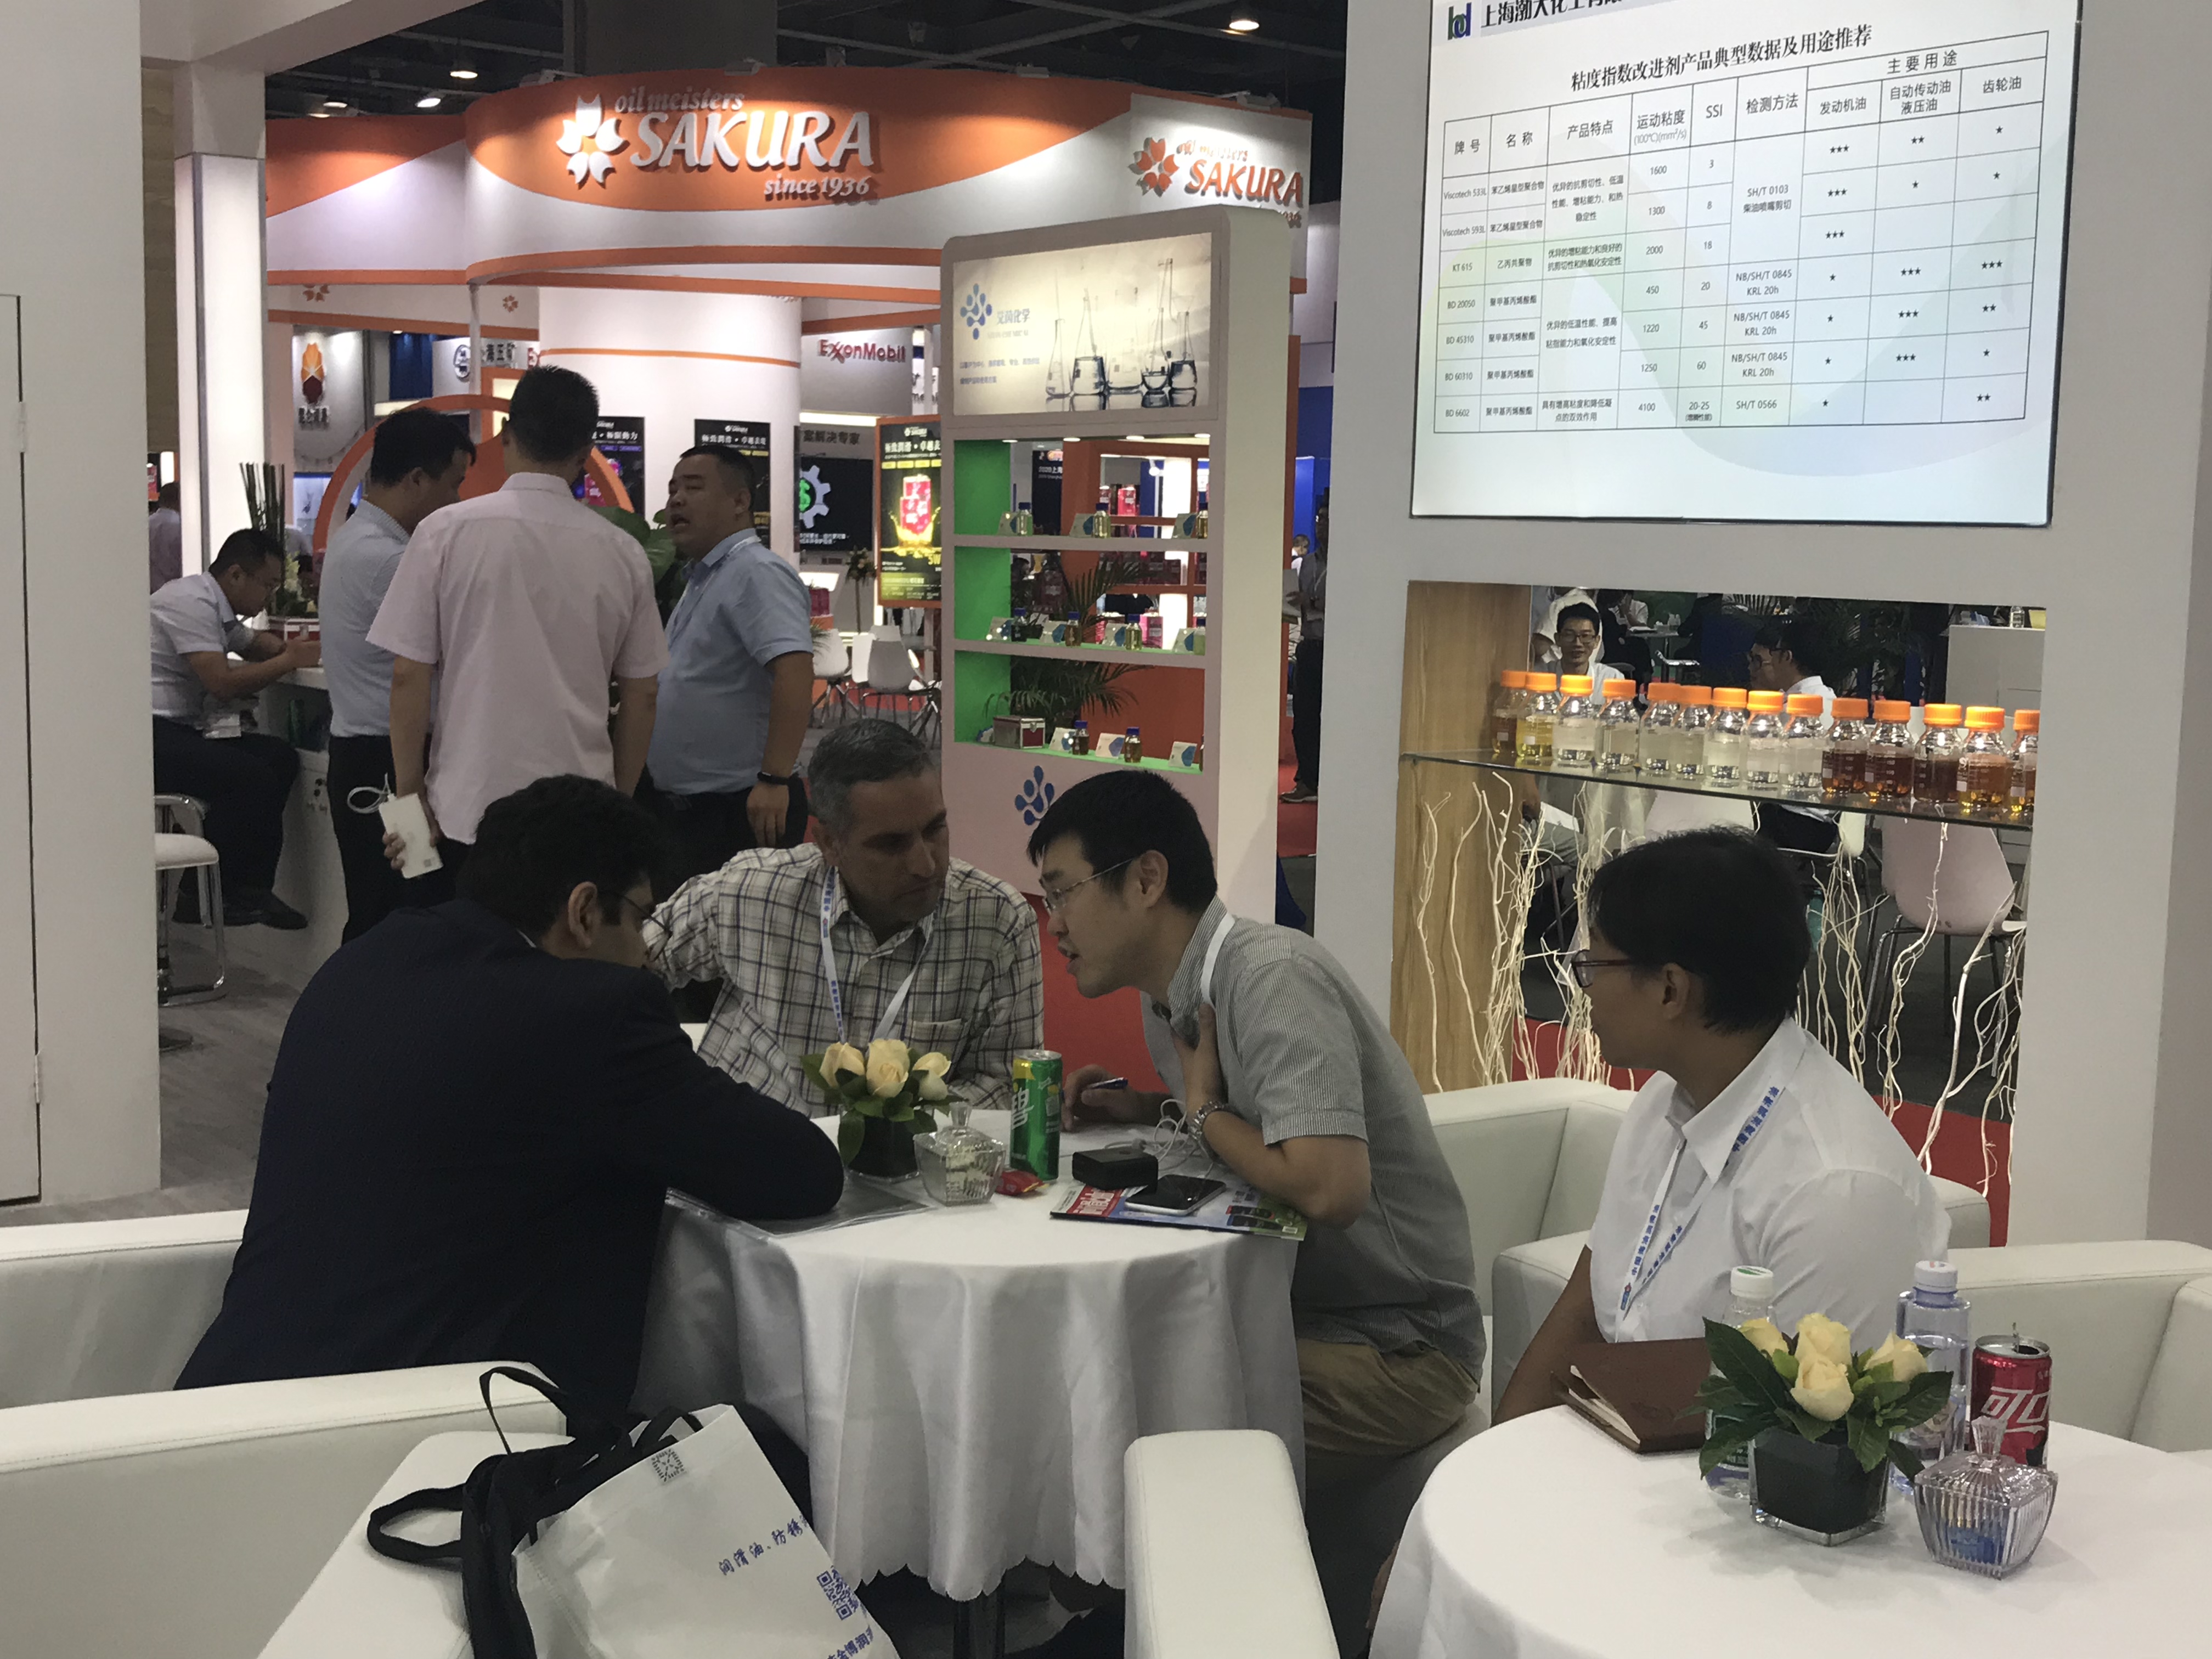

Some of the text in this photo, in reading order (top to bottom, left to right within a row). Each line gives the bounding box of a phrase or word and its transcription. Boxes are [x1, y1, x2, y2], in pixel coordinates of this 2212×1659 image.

[1480, 0, 1617, 28] 上海渤大化
[1571, 24, 1872, 92] 粘度指数改进剂产品典型数据及用途推荐
[1887, 49, 1959, 75] 主要用途
[1889, 79, 1952, 101] 自动传动油
[1982, 76, 2022, 94] 齿轮油
[614, 86, 744, 112] oil meisters
[1746, 93, 1799, 115] 检测方法
[1706, 104, 1723, 119] SSI
[1819, 97, 1867, 116] 发动机油
[1900, 98, 1938, 115] 液压油
[1637, 109, 1686, 130] 运动粘度
[1567, 120, 1613, 140] 产品特点
[629, 111, 874, 168] SAKURA
[1506, 131, 1533, 148] 名称
[1454, 138, 1481, 155] 牌号
[1709, 159, 1714, 168] 3
[1650, 165, 1667, 176] 1600
[764, 176, 870, 197] since 1936
[1187, 159, 1302, 205] SAKURA
[1443, 188, 1472, 200] Viscotech
[1747, 184, 1789, 198] SH/T 0103
[1648, 206, 1666, 216] 1300
[1707, 201, 1712, 210] 8
[1442, 227, 1470, 238] Viscotech
[1646, 245, 1664, 255] 2000
[1703, 240, 1712, 250] 18
[1452, 262, 1473, 272] KT 615
[1735, 268, 1792, 283] NB/SH/T 0845
[1646, 285, 1660, 295] 450
[1701, 281, 1711, 291] 20
[1747, 285, 1779, 296] KRL 20h
[1447, 300, 1476, 309] BD 20050
[1734, 309, 1790, 322] NB/SH/T 0845
[1643, 324, 1660, 334] 1220
[1699, 320, 1708, 330] 45
[1745, 326, 1777, 336] KRL 20h
[1446, 335, 1475, 345] BD 45310
[819, 339, 906, 363] ExxonMobil
[1731, 351, 1788, 363] NB/SH/T 0845
[1641, 363, 1658, 373] 1250
[1696, 360, 1707, 370] 60
[1444, 372, 1473, 381] BD 60310
[1742, 367, 1774, 377] KRL 20h
[1638, 402, 1656, 412] 4100
[1689, 401, 1710, 410] 20-25
[1736, 399, 1778, 410] SH/T 0566
[1445, 409, 1470, 417] BD 6602
